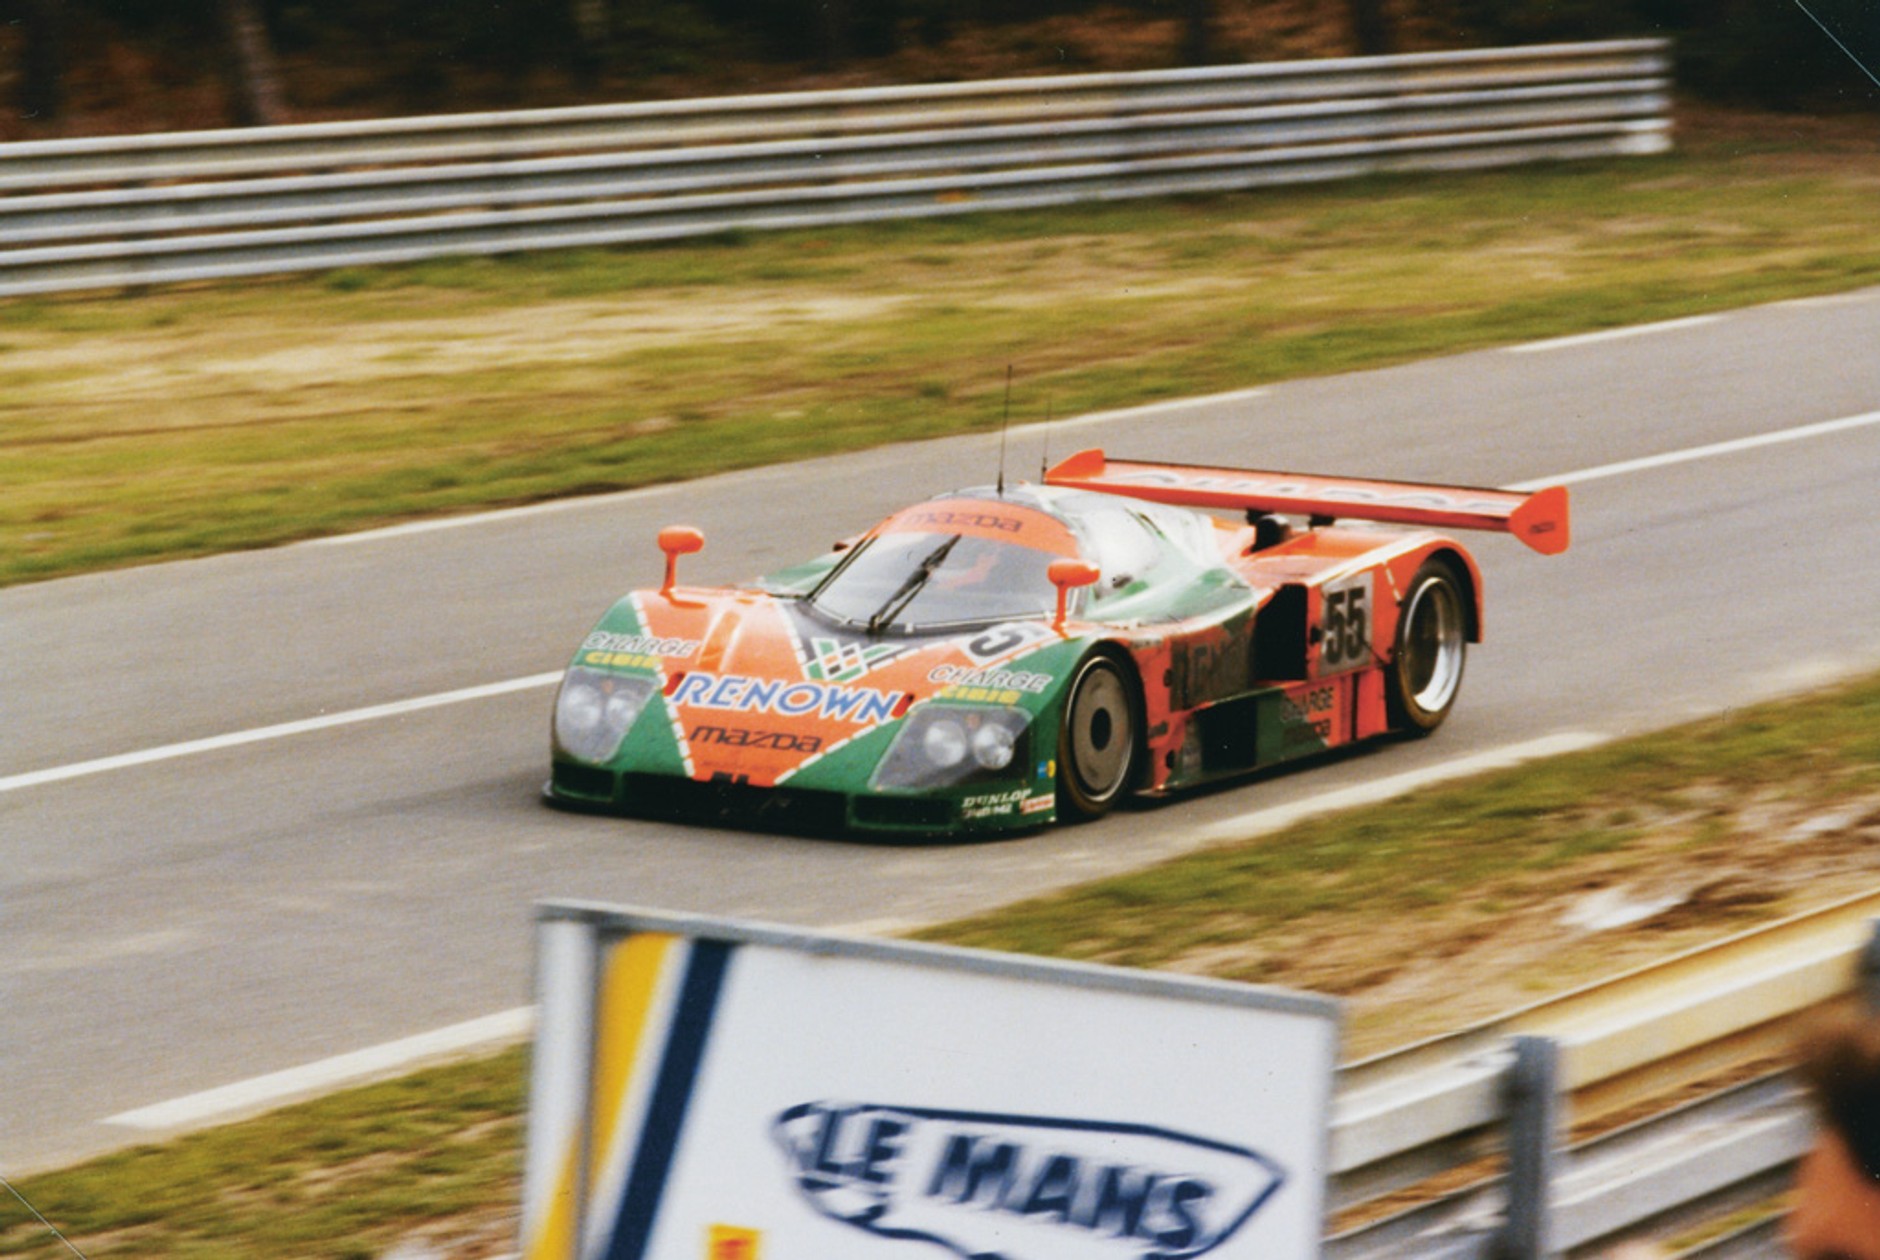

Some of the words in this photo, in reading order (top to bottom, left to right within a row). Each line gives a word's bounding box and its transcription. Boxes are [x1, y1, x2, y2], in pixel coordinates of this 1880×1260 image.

[1325, 586, 1366, 665] 55
[583, 630, 702, 659] CHARGE
[928, 663, 1053, 693] CHARGE
[671, 671, 905, 724] RENOWN
[689, 725, 824, 752] mazda
[962, 788, 1033, 808] DUNLOP
[812, 1108, 906, 1185] LE
[926, 1133, 1214, 1250] MANS
